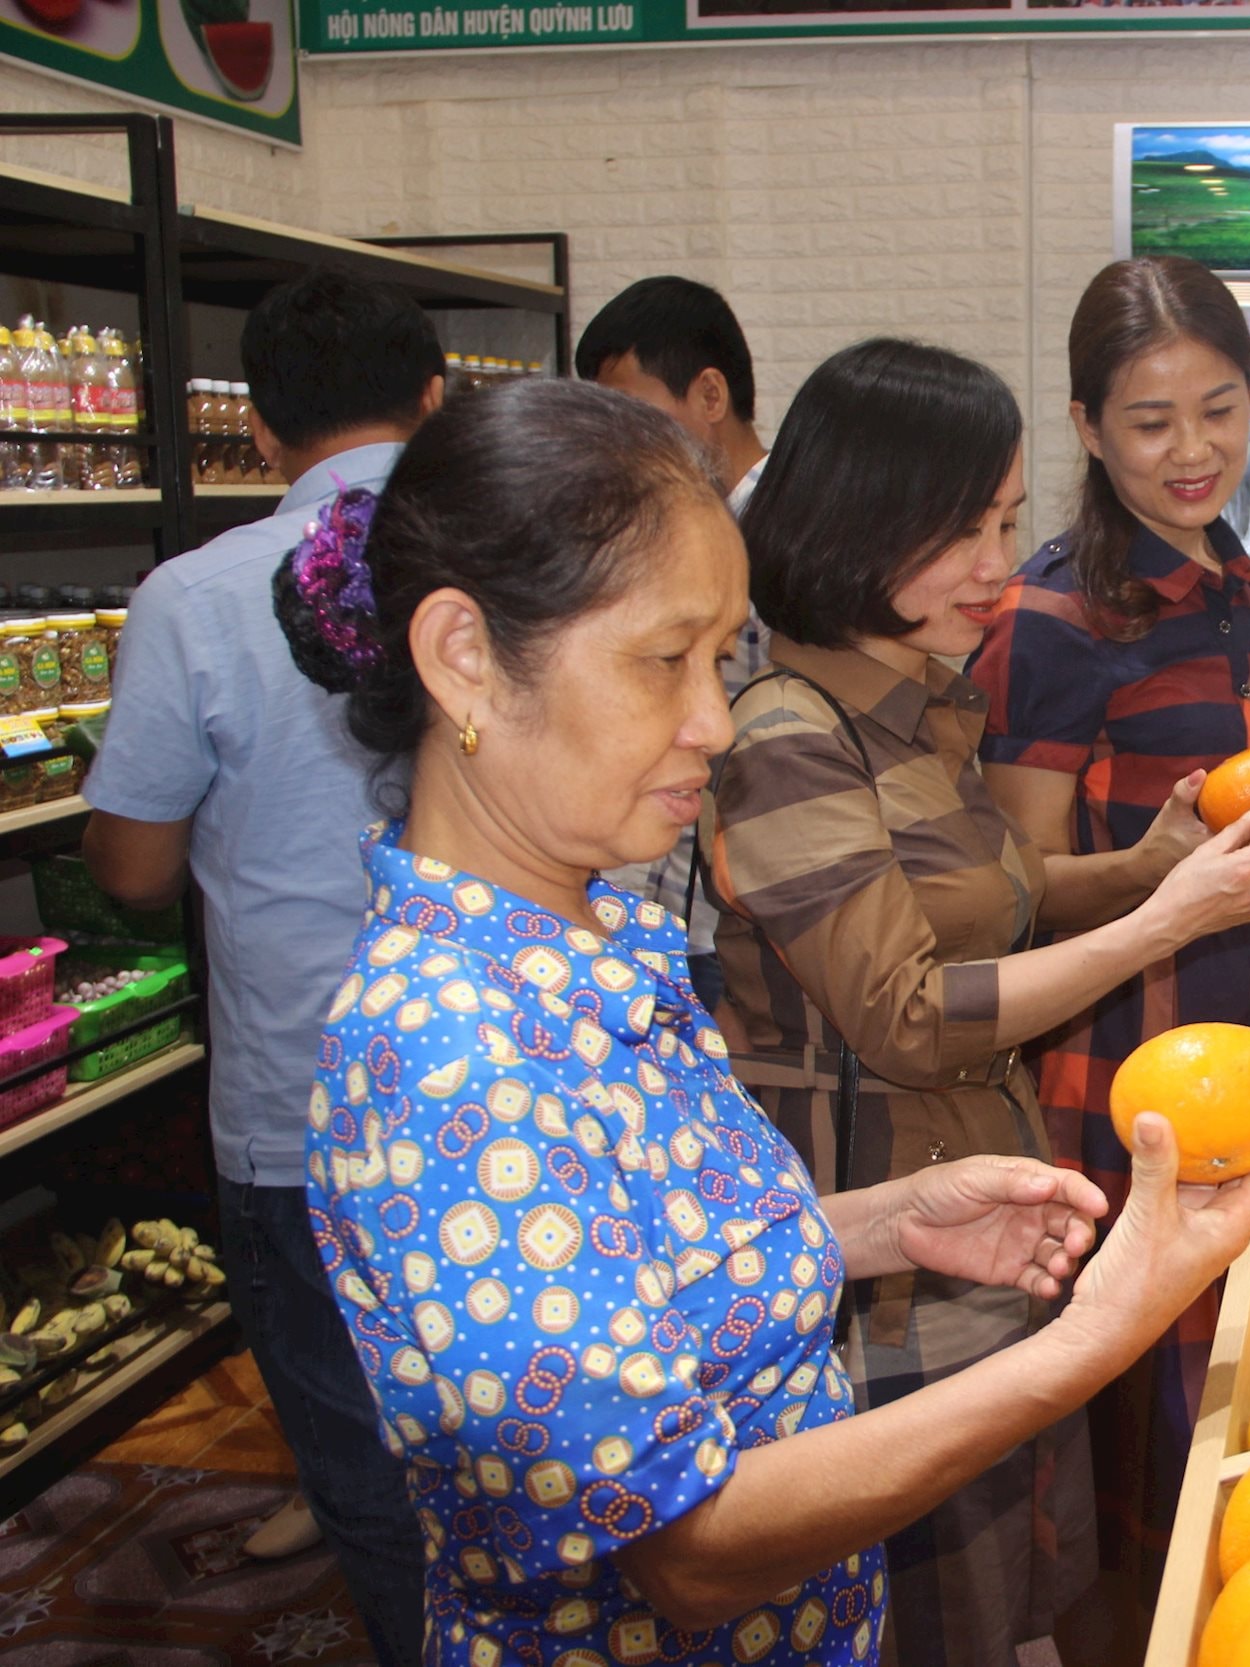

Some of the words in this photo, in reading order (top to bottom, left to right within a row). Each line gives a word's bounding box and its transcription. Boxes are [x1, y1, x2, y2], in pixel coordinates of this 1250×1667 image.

[328, 9, 359, 45] HỘI
[363, 7, 416, 39] NÔNG
[420, 6, 459, 37] DÂN
[463, 4, 525, 40] HUYỆN
[529, 2, 593, 36] QUỲNH
[597, 3, 634, 31] LƯU
